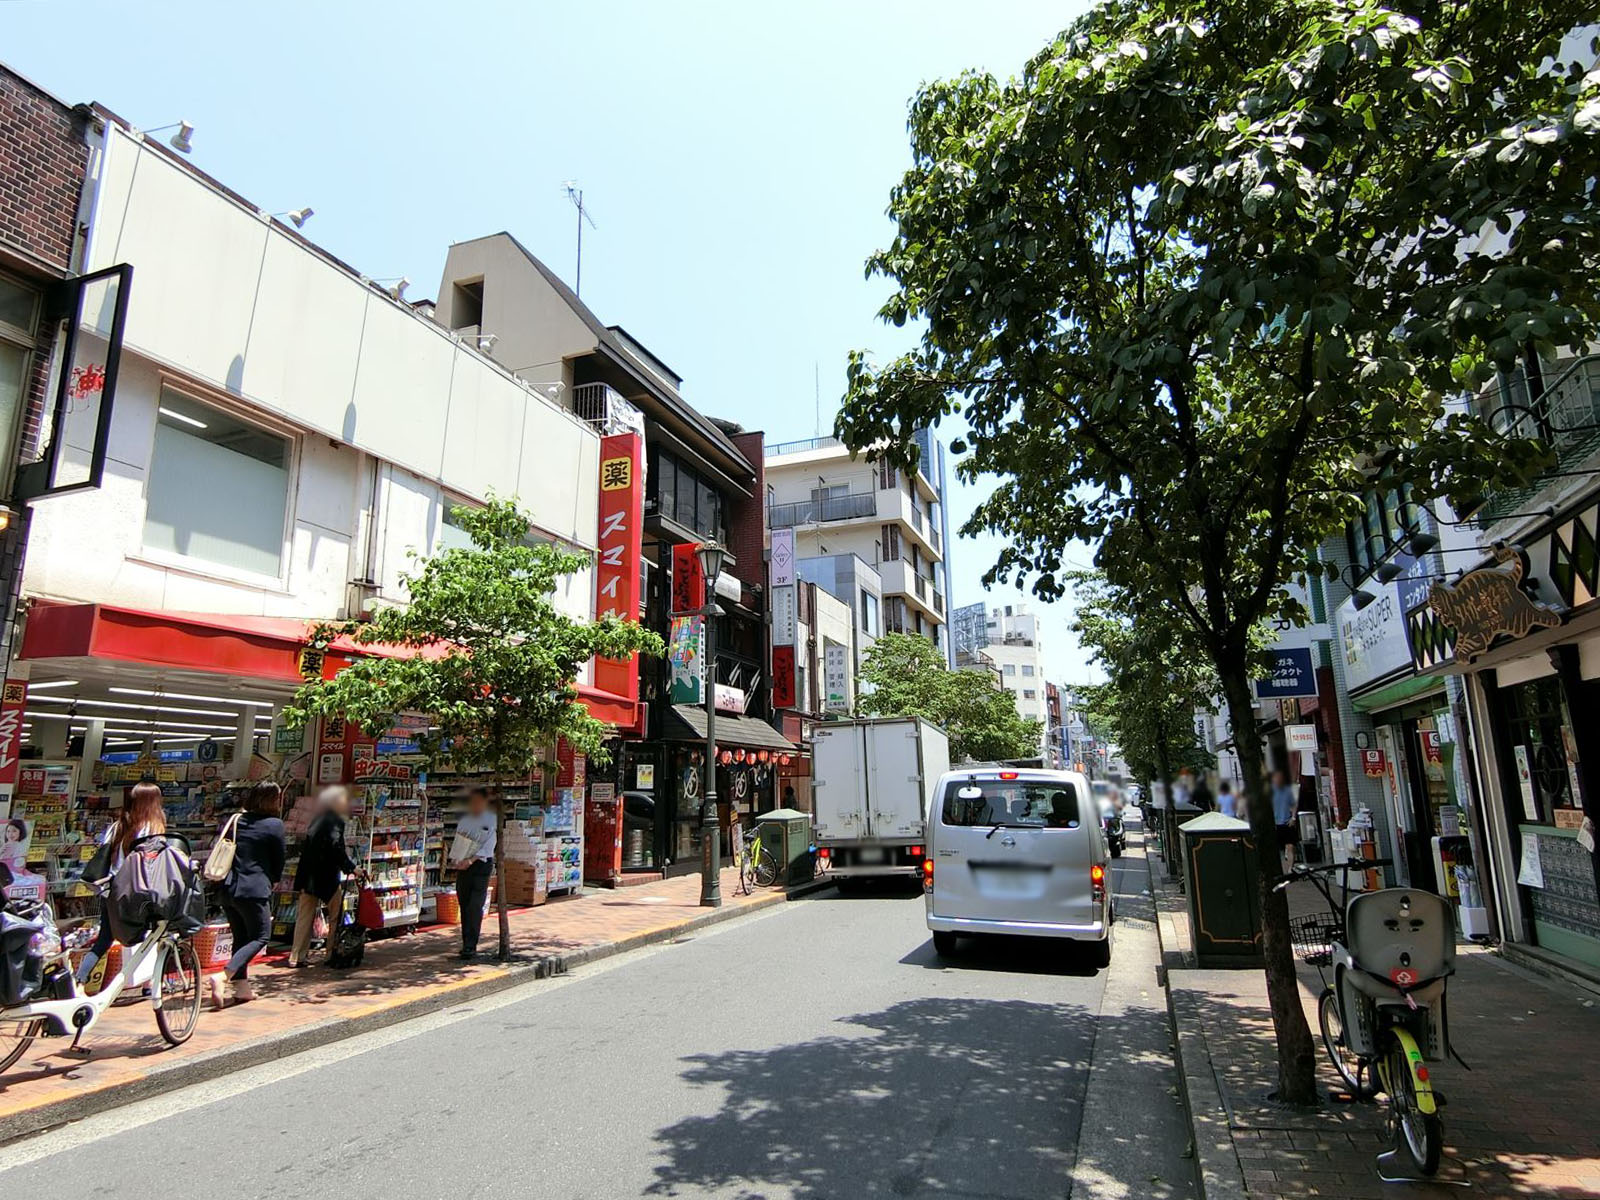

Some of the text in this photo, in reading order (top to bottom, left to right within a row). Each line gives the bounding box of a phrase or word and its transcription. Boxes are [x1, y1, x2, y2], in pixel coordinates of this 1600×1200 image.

[604, 461, 628, 488] 薬
[777, 576, 787, 584] 3F
[1405, 581, 1430, 608] コンタクト
[302, 651, 321, 674] 薬
[1271, 678, 1298, 687] 補聴器
[5, 685, 23, 702] 薬
[320, 742, 346, 751] スマイル
[355, 760, 409, 778] 虫ケア用品
